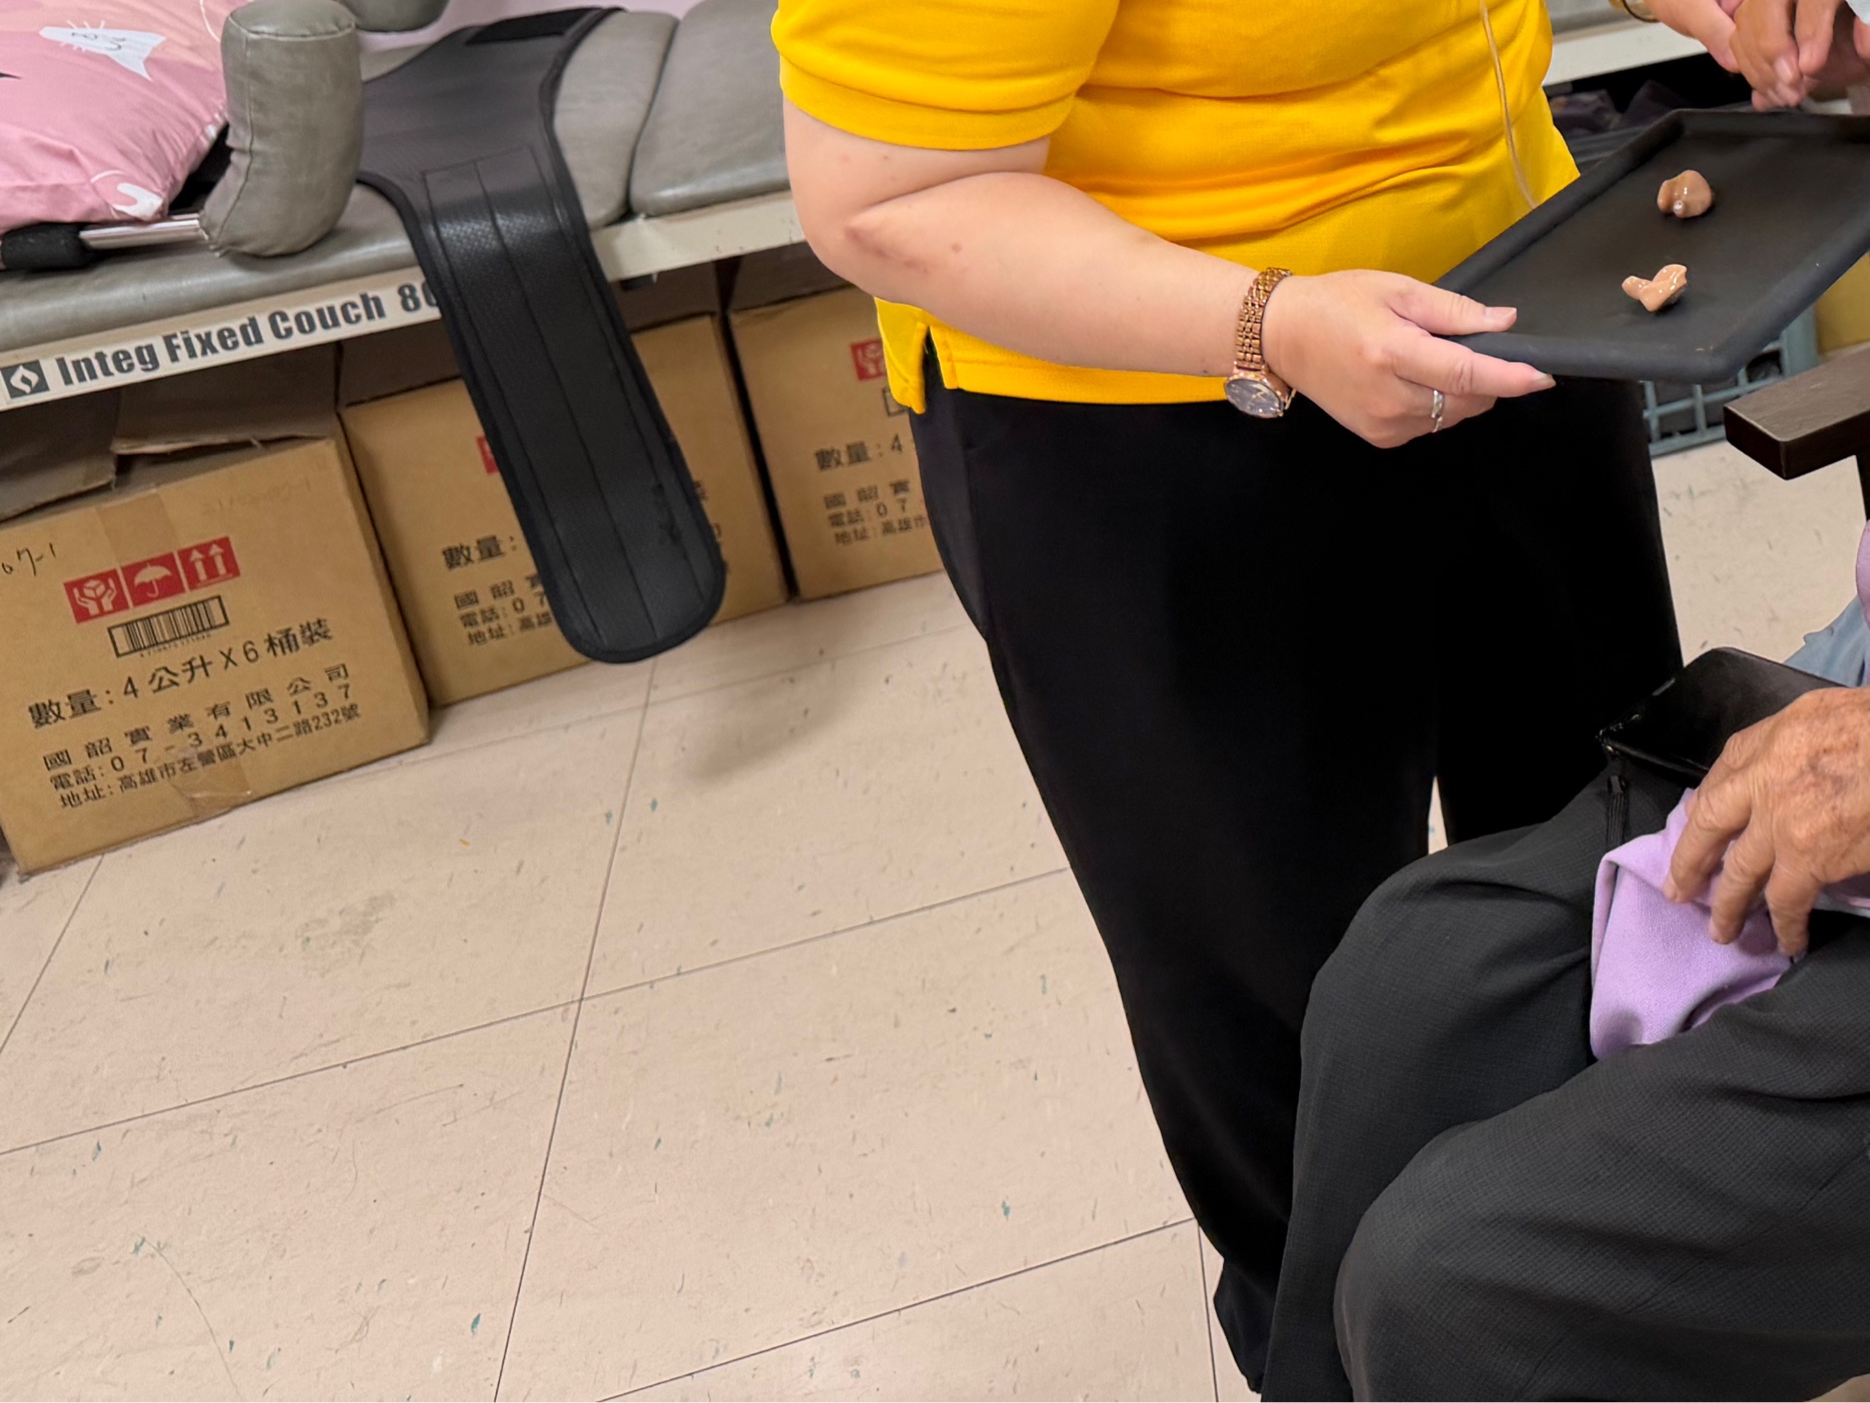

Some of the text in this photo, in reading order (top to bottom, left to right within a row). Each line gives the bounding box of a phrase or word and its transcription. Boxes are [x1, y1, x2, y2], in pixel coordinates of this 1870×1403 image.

[55, 341, 160, 386] Integ
[162, 316, 265, 364] Fixed
[267, 291, 386, 340] Couch
